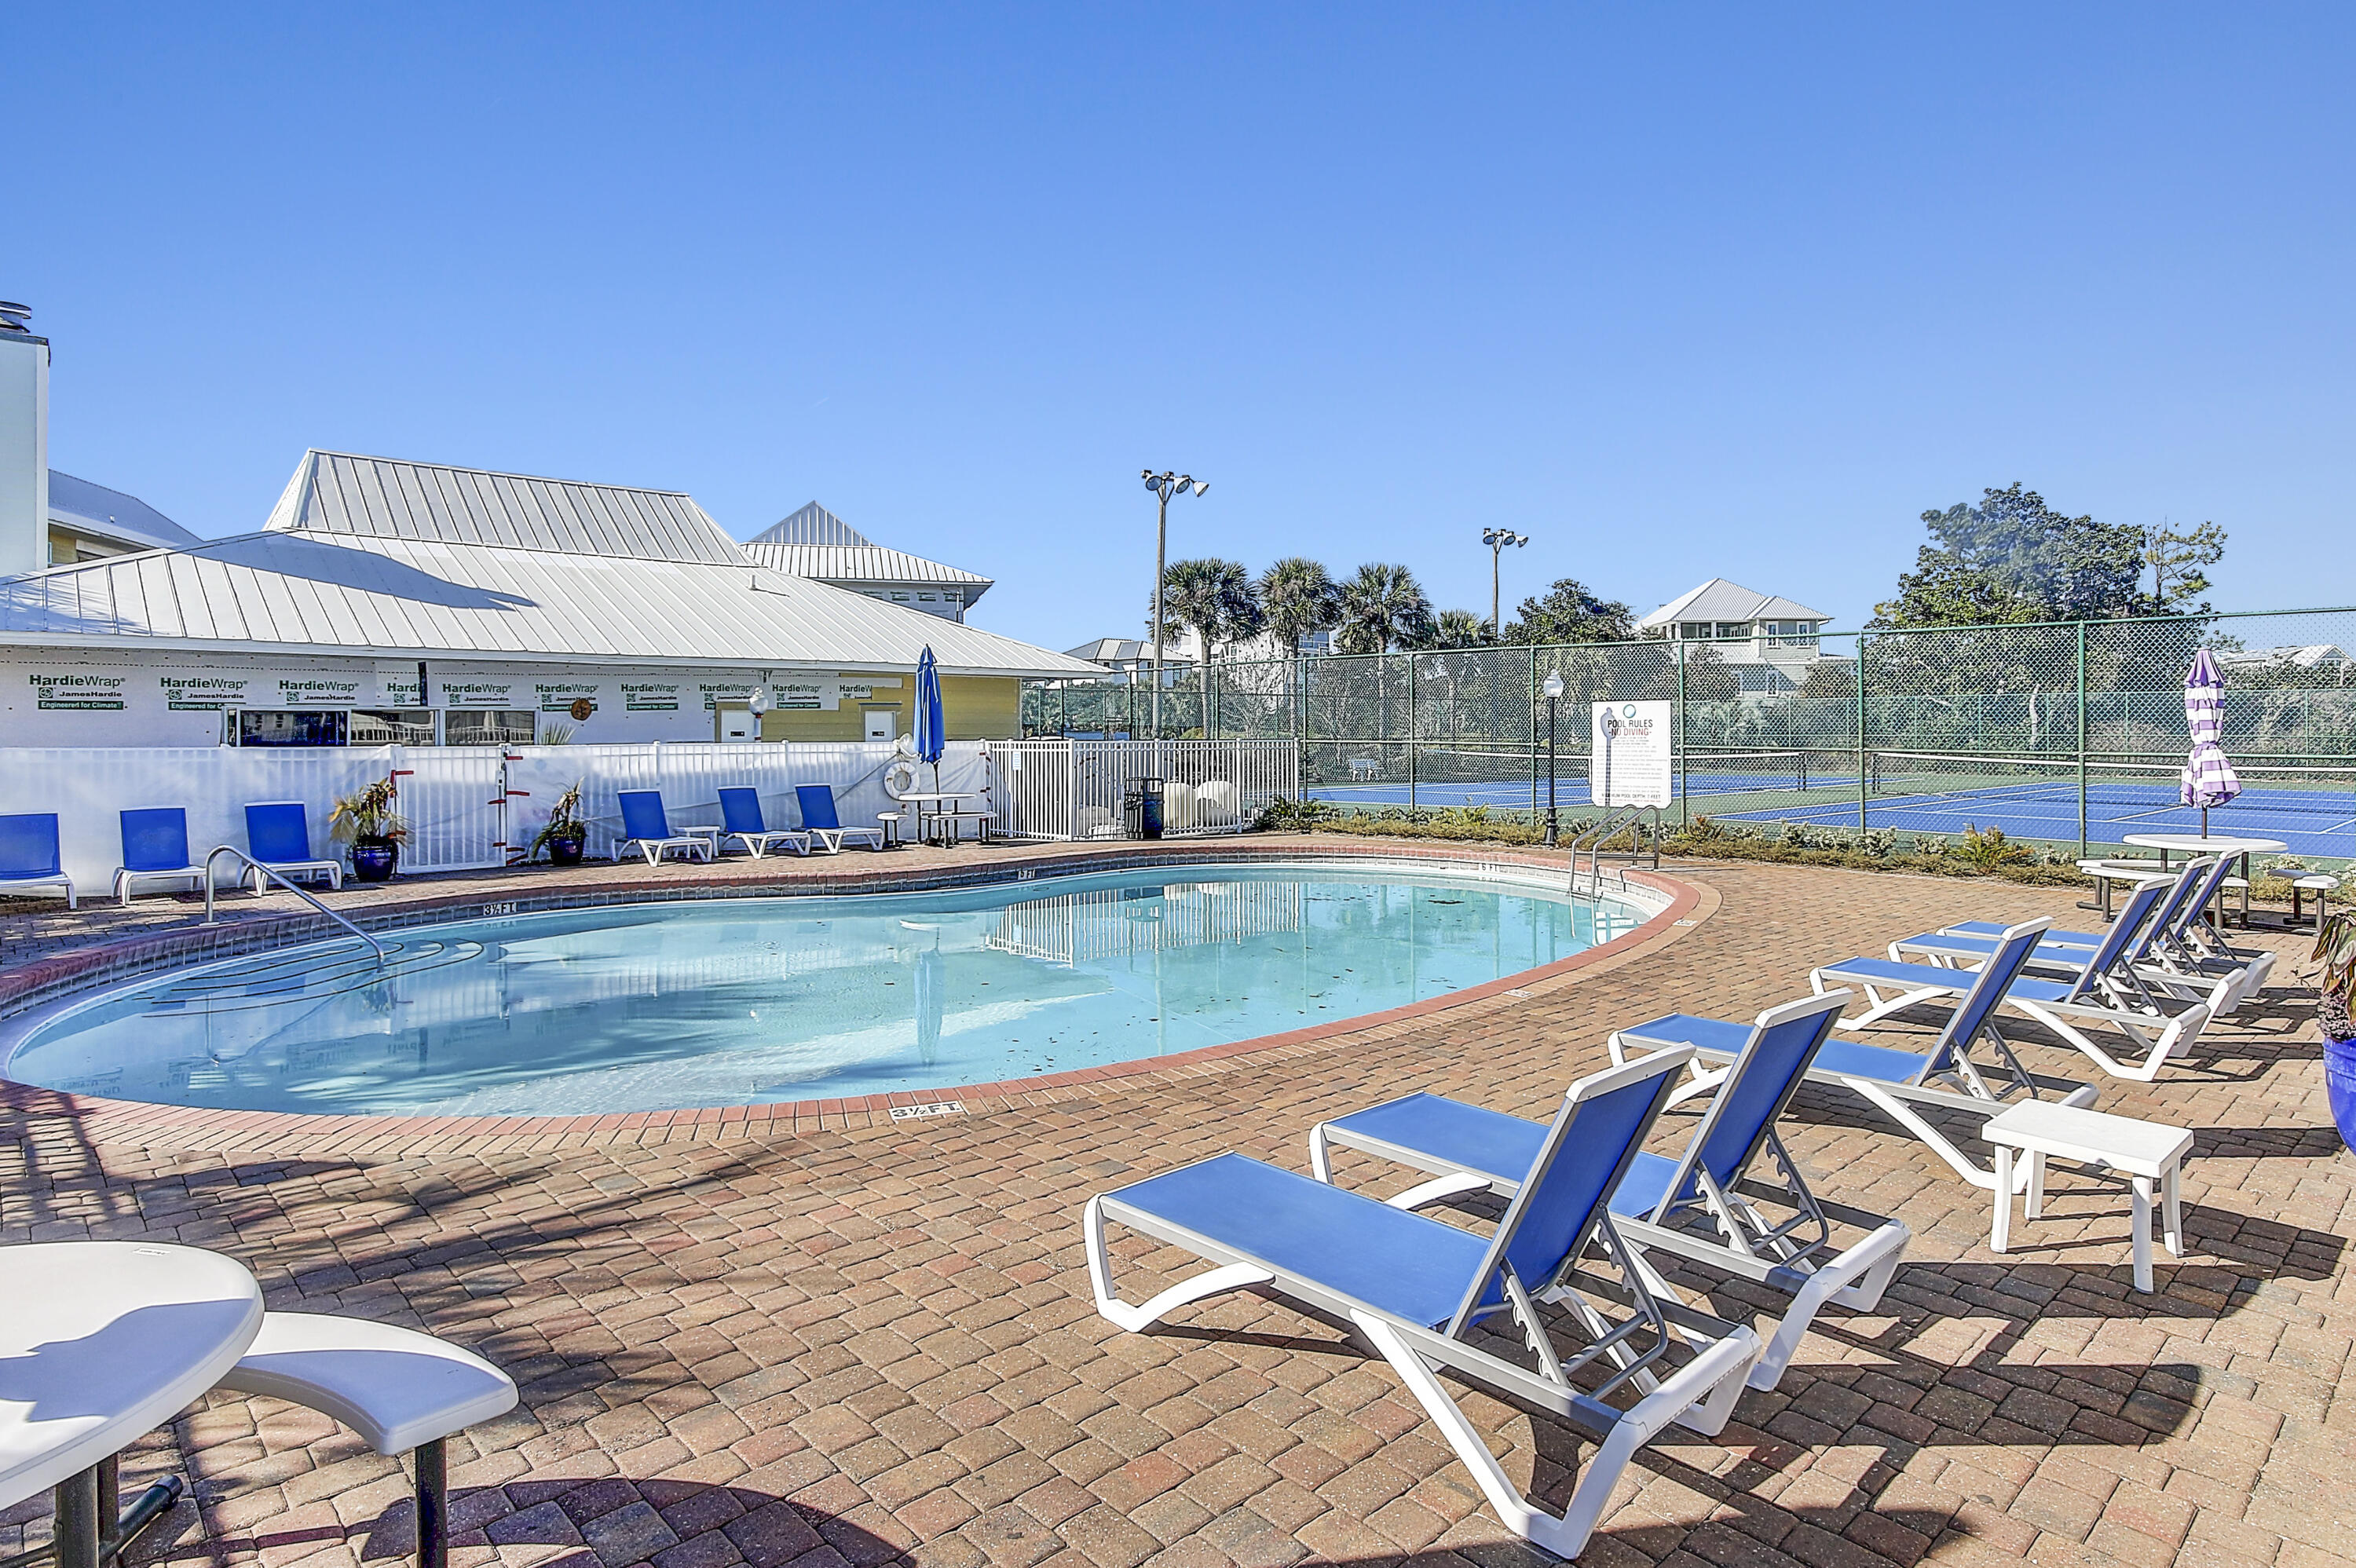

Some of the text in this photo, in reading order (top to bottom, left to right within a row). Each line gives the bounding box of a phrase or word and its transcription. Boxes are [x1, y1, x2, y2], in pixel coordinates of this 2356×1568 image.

[29, 674, 120, 689] HardieWrap
[160, 678, 243, 691] HardieWrap
[280, 680, 355, 693] HardieWrap
[387, 682, 420, 692] Hardi
[442, 684, 508, 693] HardieWrap
[536, 684, 595, 693] HardieWrap
[621, 684, 676, 693] HardieWrap
[699, 684, 750, 693] HardieWrap
[772, 684, 819, 693] HardieWrap
[1608, 719, 1653, 728] POOL RULES
